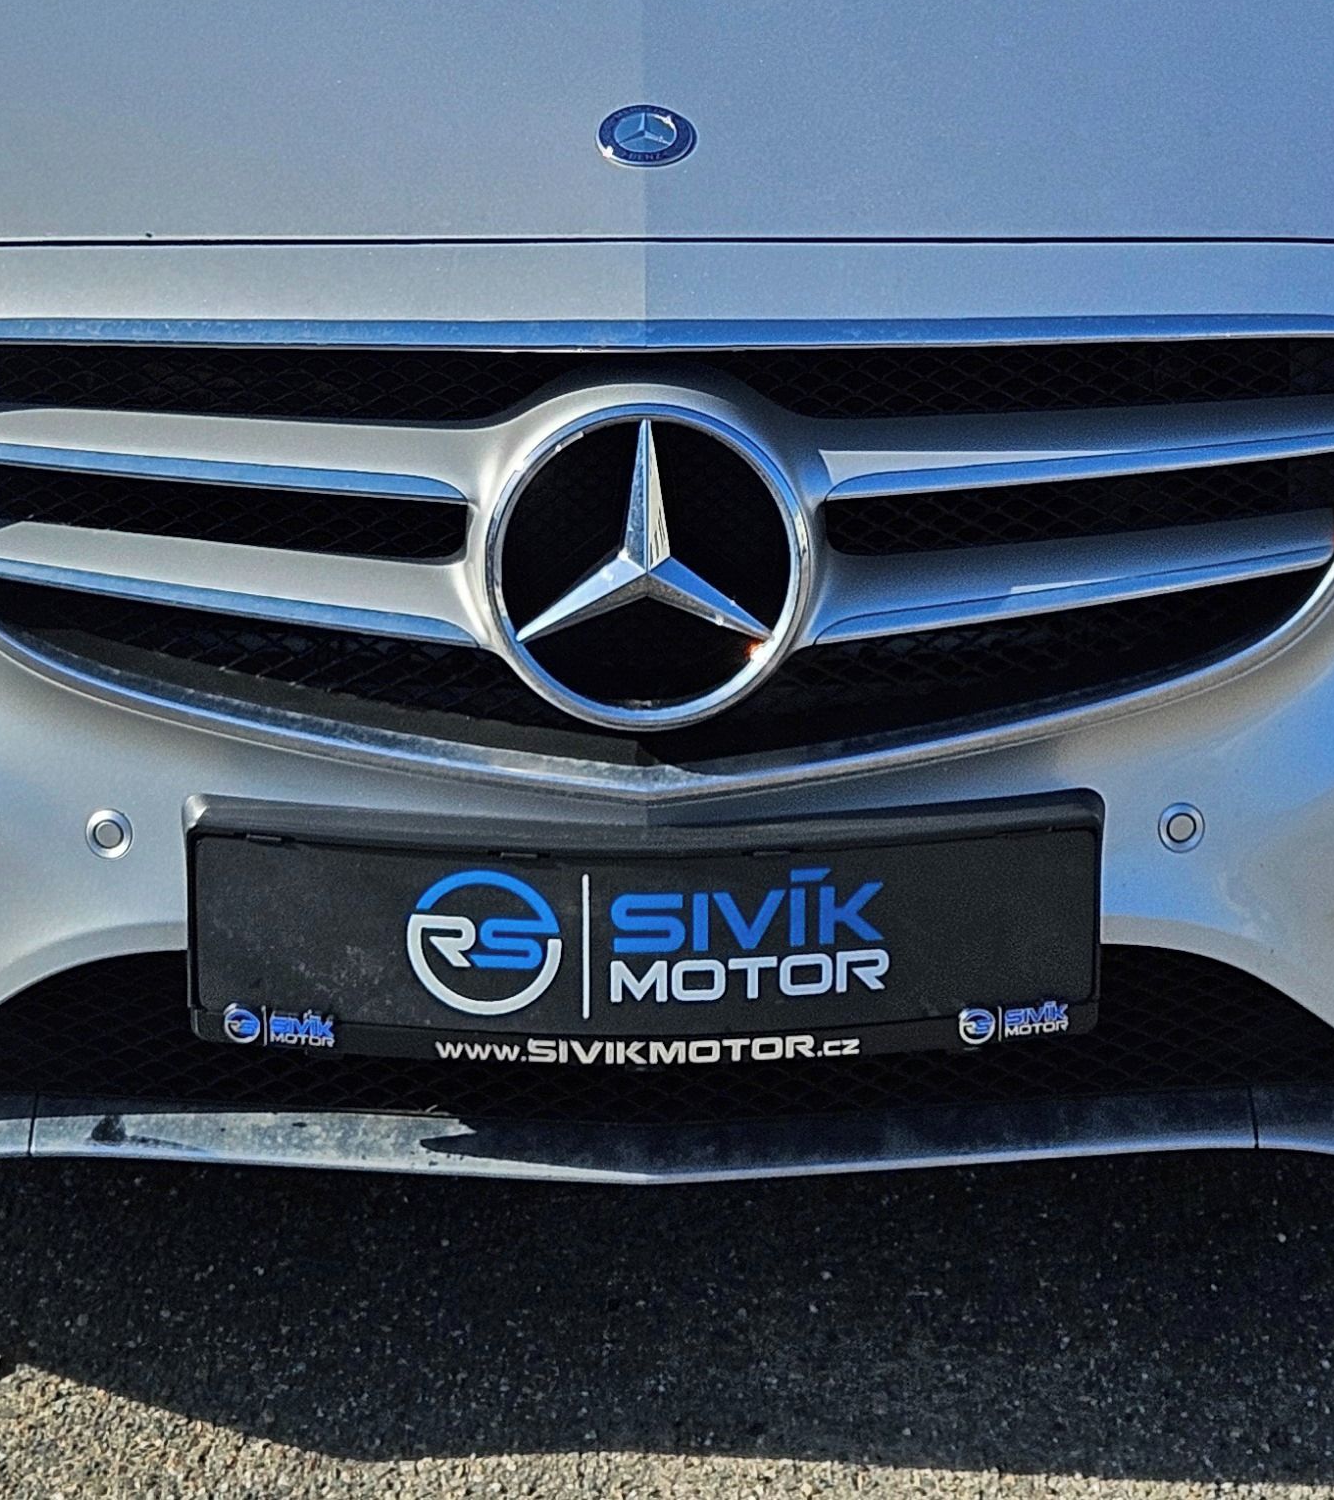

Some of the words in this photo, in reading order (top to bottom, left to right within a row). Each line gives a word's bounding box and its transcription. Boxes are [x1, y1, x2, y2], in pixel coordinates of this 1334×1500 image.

[611, 949, 889, 1003] MOTOR
[270, 1033, 335, 1047] MOTOR
[1005, 1020, 1068, 1038] MOTOR
[435, 1035, 860, 1065] www.SIVIKMOTOR.cz
